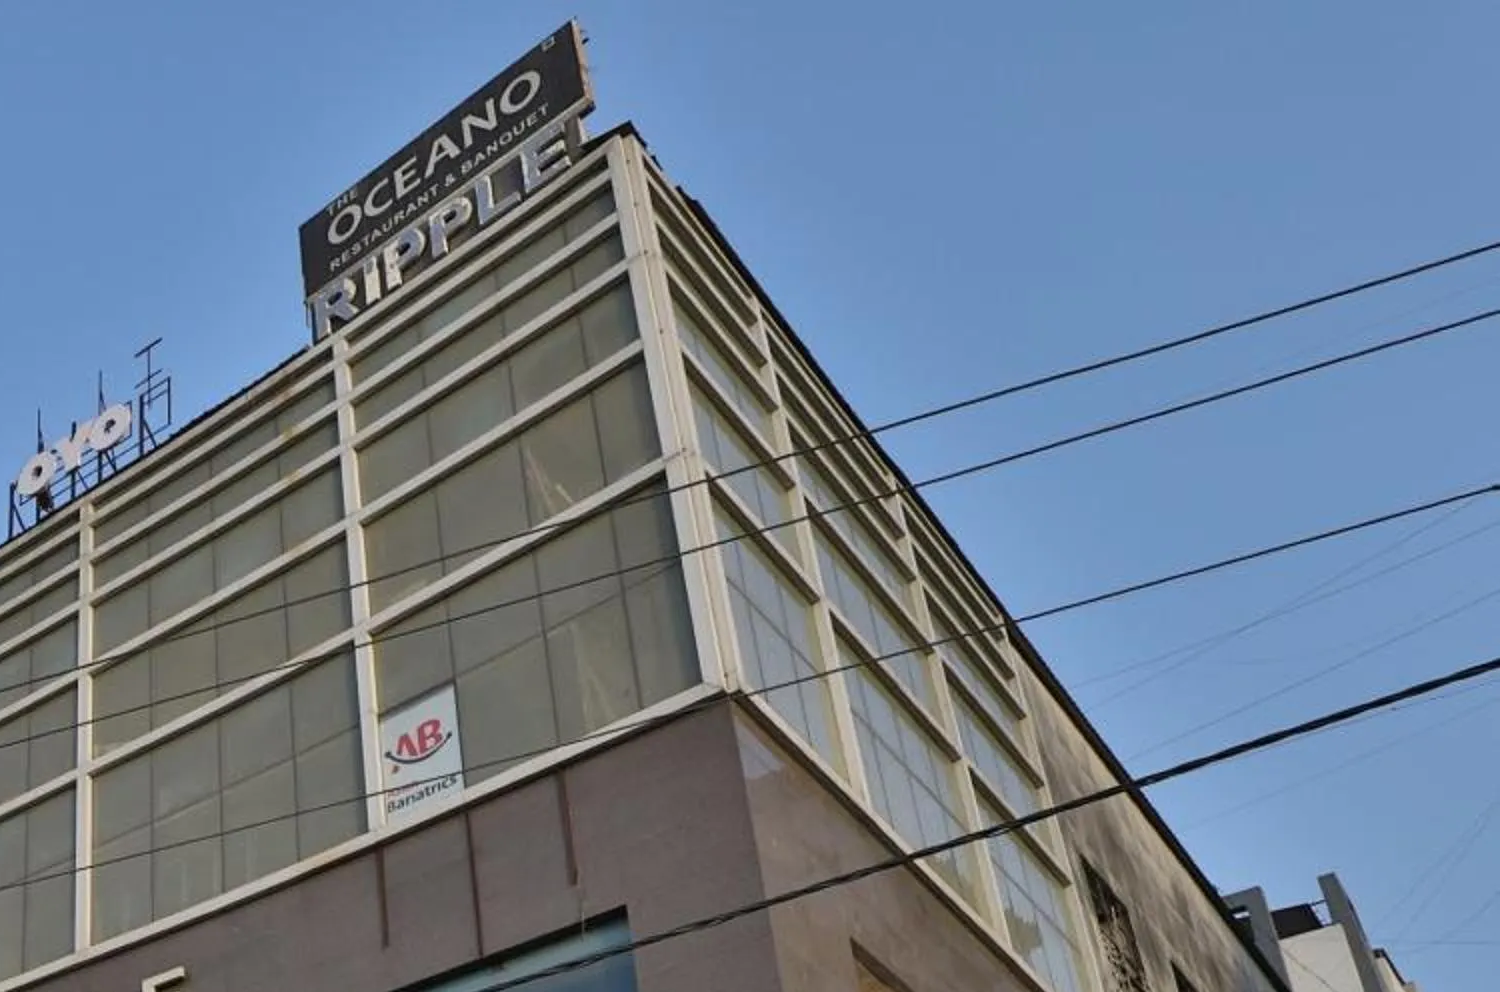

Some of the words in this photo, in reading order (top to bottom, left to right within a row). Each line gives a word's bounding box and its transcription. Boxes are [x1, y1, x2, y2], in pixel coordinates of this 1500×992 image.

[312, 116, 573, 338] RIPPLE
[327, 187, 358, 216] THE
[328, 69, 541, 246] OCEANO
[330, 181, 441, 272] RESTAURANT
[460, 102, 550, 174] BANQUET
[17, 403, 133, 496] OYO
